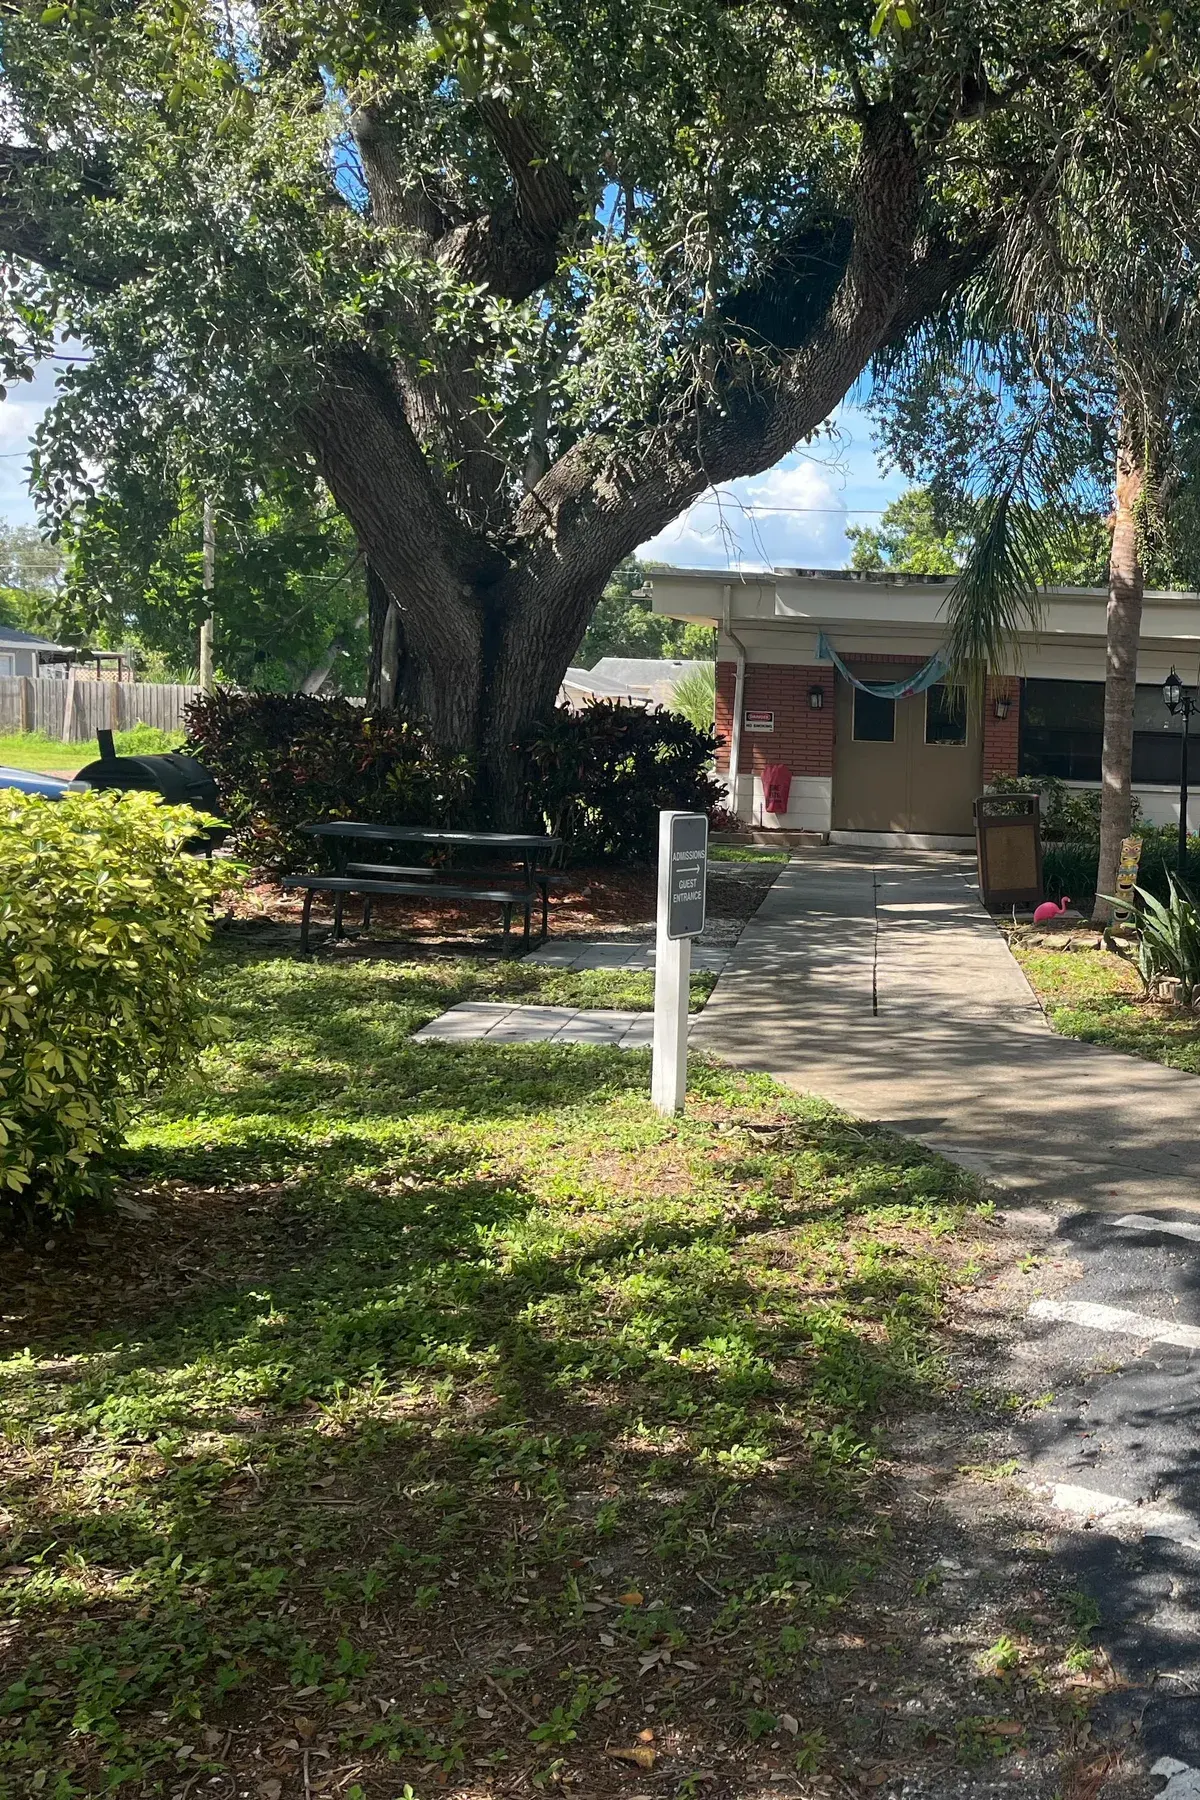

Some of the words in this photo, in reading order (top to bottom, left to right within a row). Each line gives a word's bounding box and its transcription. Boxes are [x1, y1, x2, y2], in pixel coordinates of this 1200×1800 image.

[672, 850, 705, 862] ADMISSIONS
[678, 878, 697, 889] GUEST
[673, 890, 702, 903] ENTRANCE
